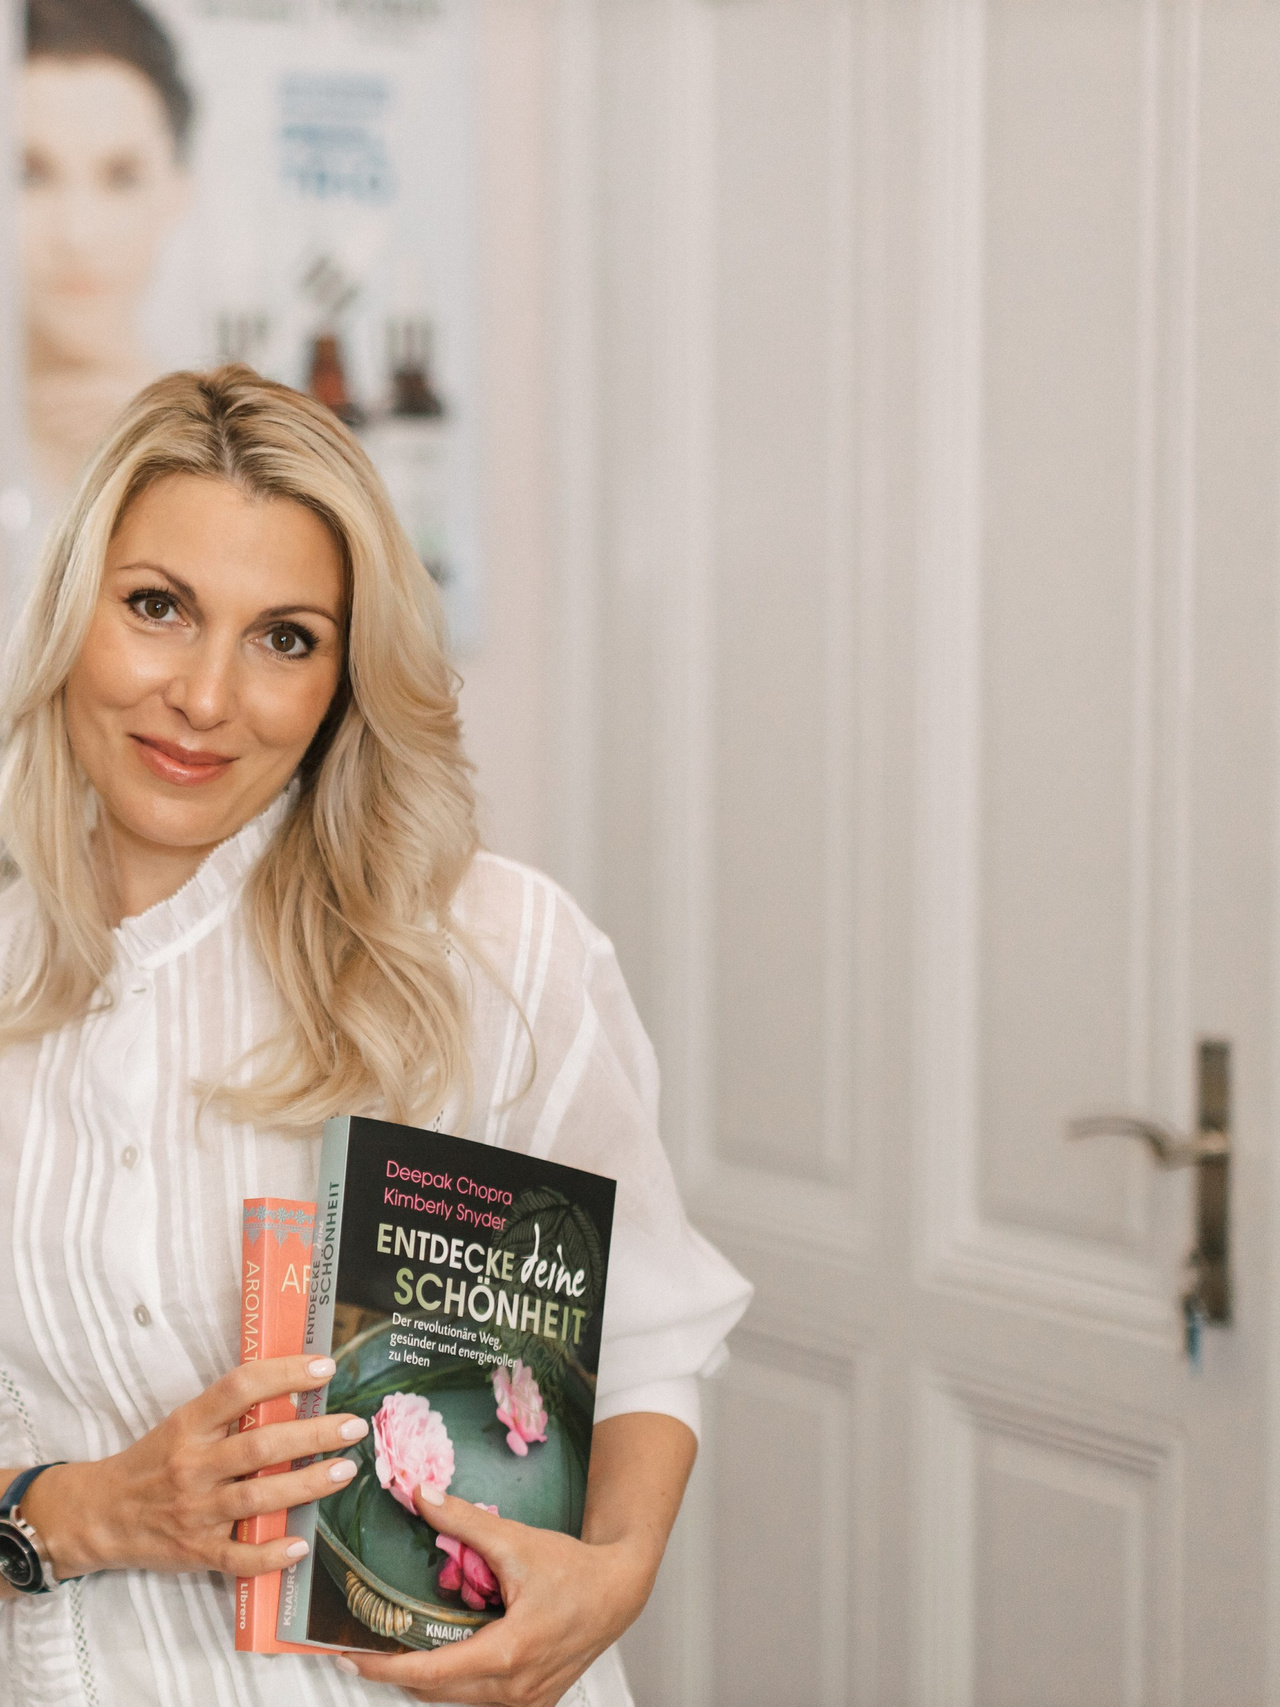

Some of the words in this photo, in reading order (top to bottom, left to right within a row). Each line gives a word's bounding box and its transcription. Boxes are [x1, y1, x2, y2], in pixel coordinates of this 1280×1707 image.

[386, 1160, 453, 1191] Deepak
[456, 1176, 513, 1205] Chopra
[383, 1187, 454, 1221] Kimberly
[456, 1203, 507, 1231] Snyder
[319, 1181, 340, 1306] SCHÖNHEIT
[376, 1222, 516, 1282] ENTDECKE
[520, 1222, 586, 1298] deine
[305, 1260, 321, 1345] ENTDECKE
[393, 1267, 586, 1345] SCHÖNHEIT
[389, 1332, 436, 1351] gesünder
[438, 1341, 457, 1356] und
[458, 1348, 518, 1369] energievoller
[392, 1312, 412, 1328] Der
[413, 1319, 477, 1343] revolutionäre
[479, 1331, 503, 1351] Weg,
[388, 1350, 402, 1362] zu
[403, 1350, 430, 1368] leben
[239, 1582, 249, 1630] Librero
[283, 1574, 297, 1627] KNAUR
[425, 1623, 463, 1641] KNAUR
